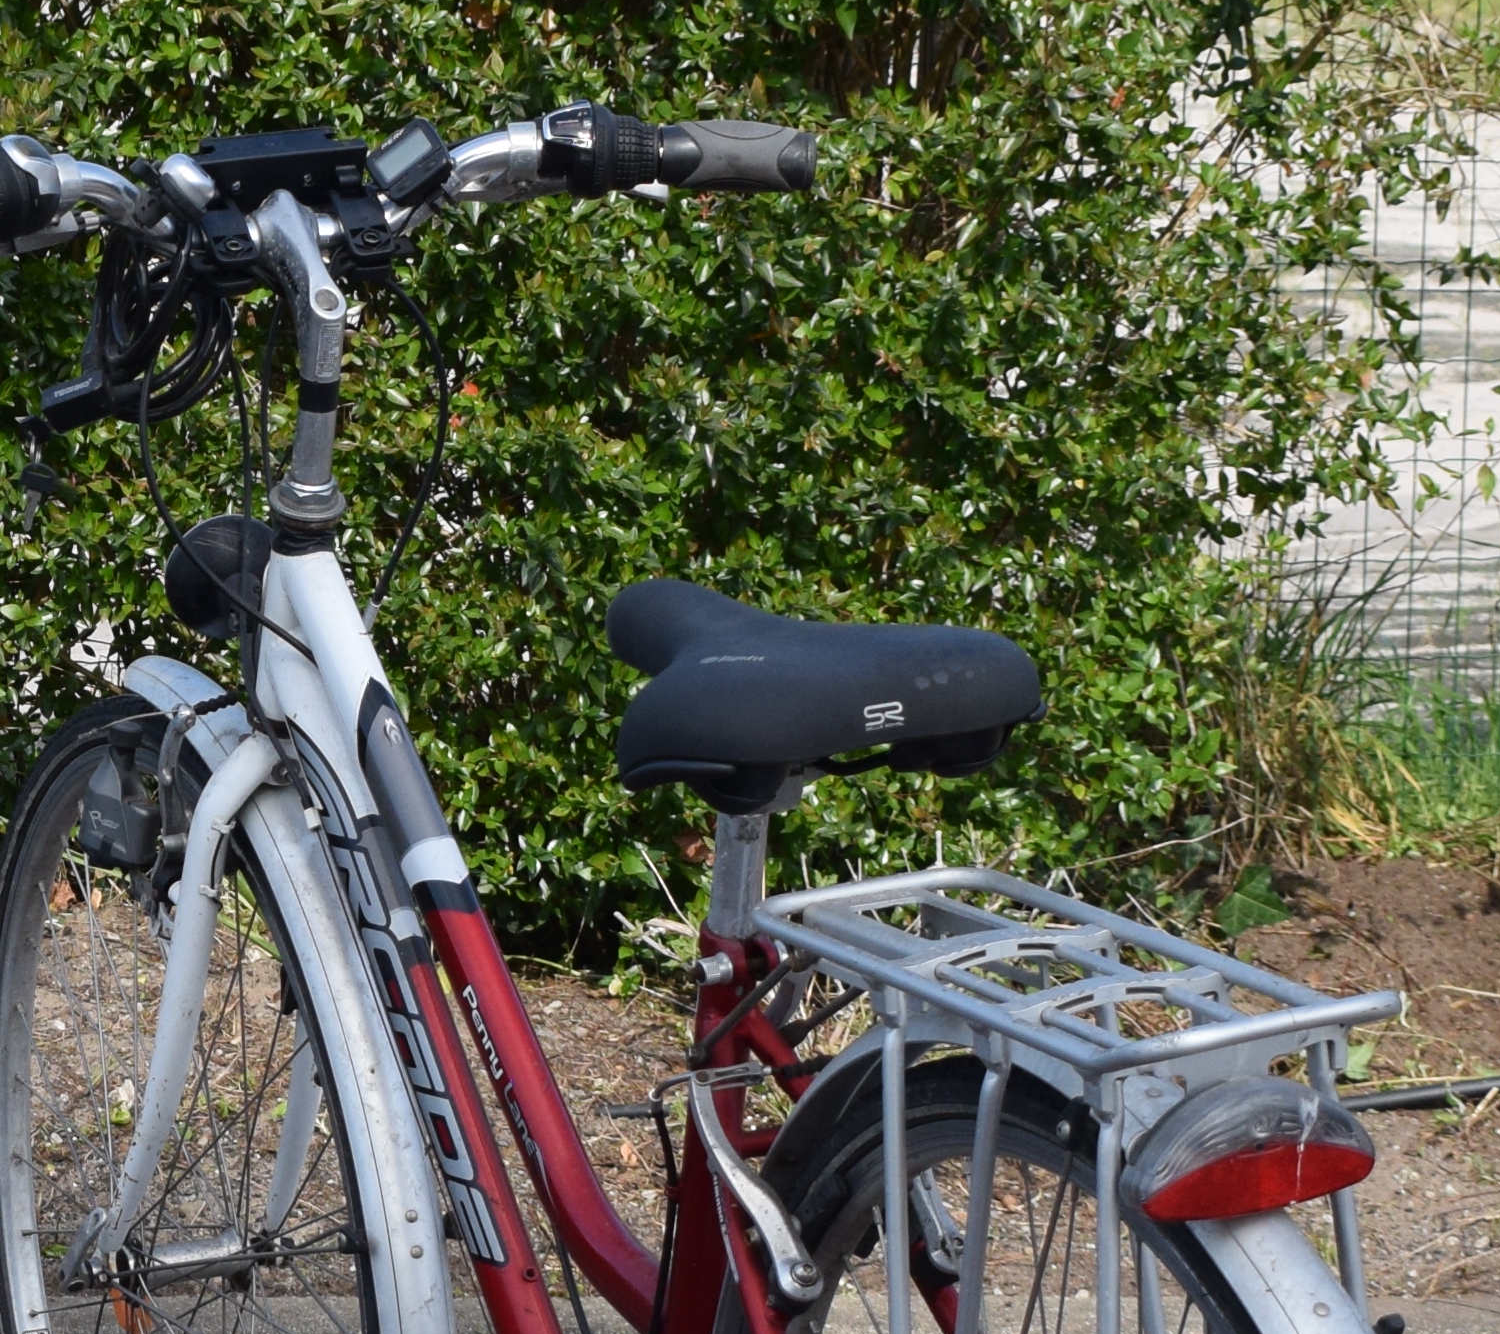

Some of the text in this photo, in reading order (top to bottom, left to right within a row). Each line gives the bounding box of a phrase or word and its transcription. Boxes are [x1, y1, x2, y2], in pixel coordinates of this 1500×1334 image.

[286, 717, 505, 1263] ARCADE
[462, 984, 540, 1157] Penny Lane
